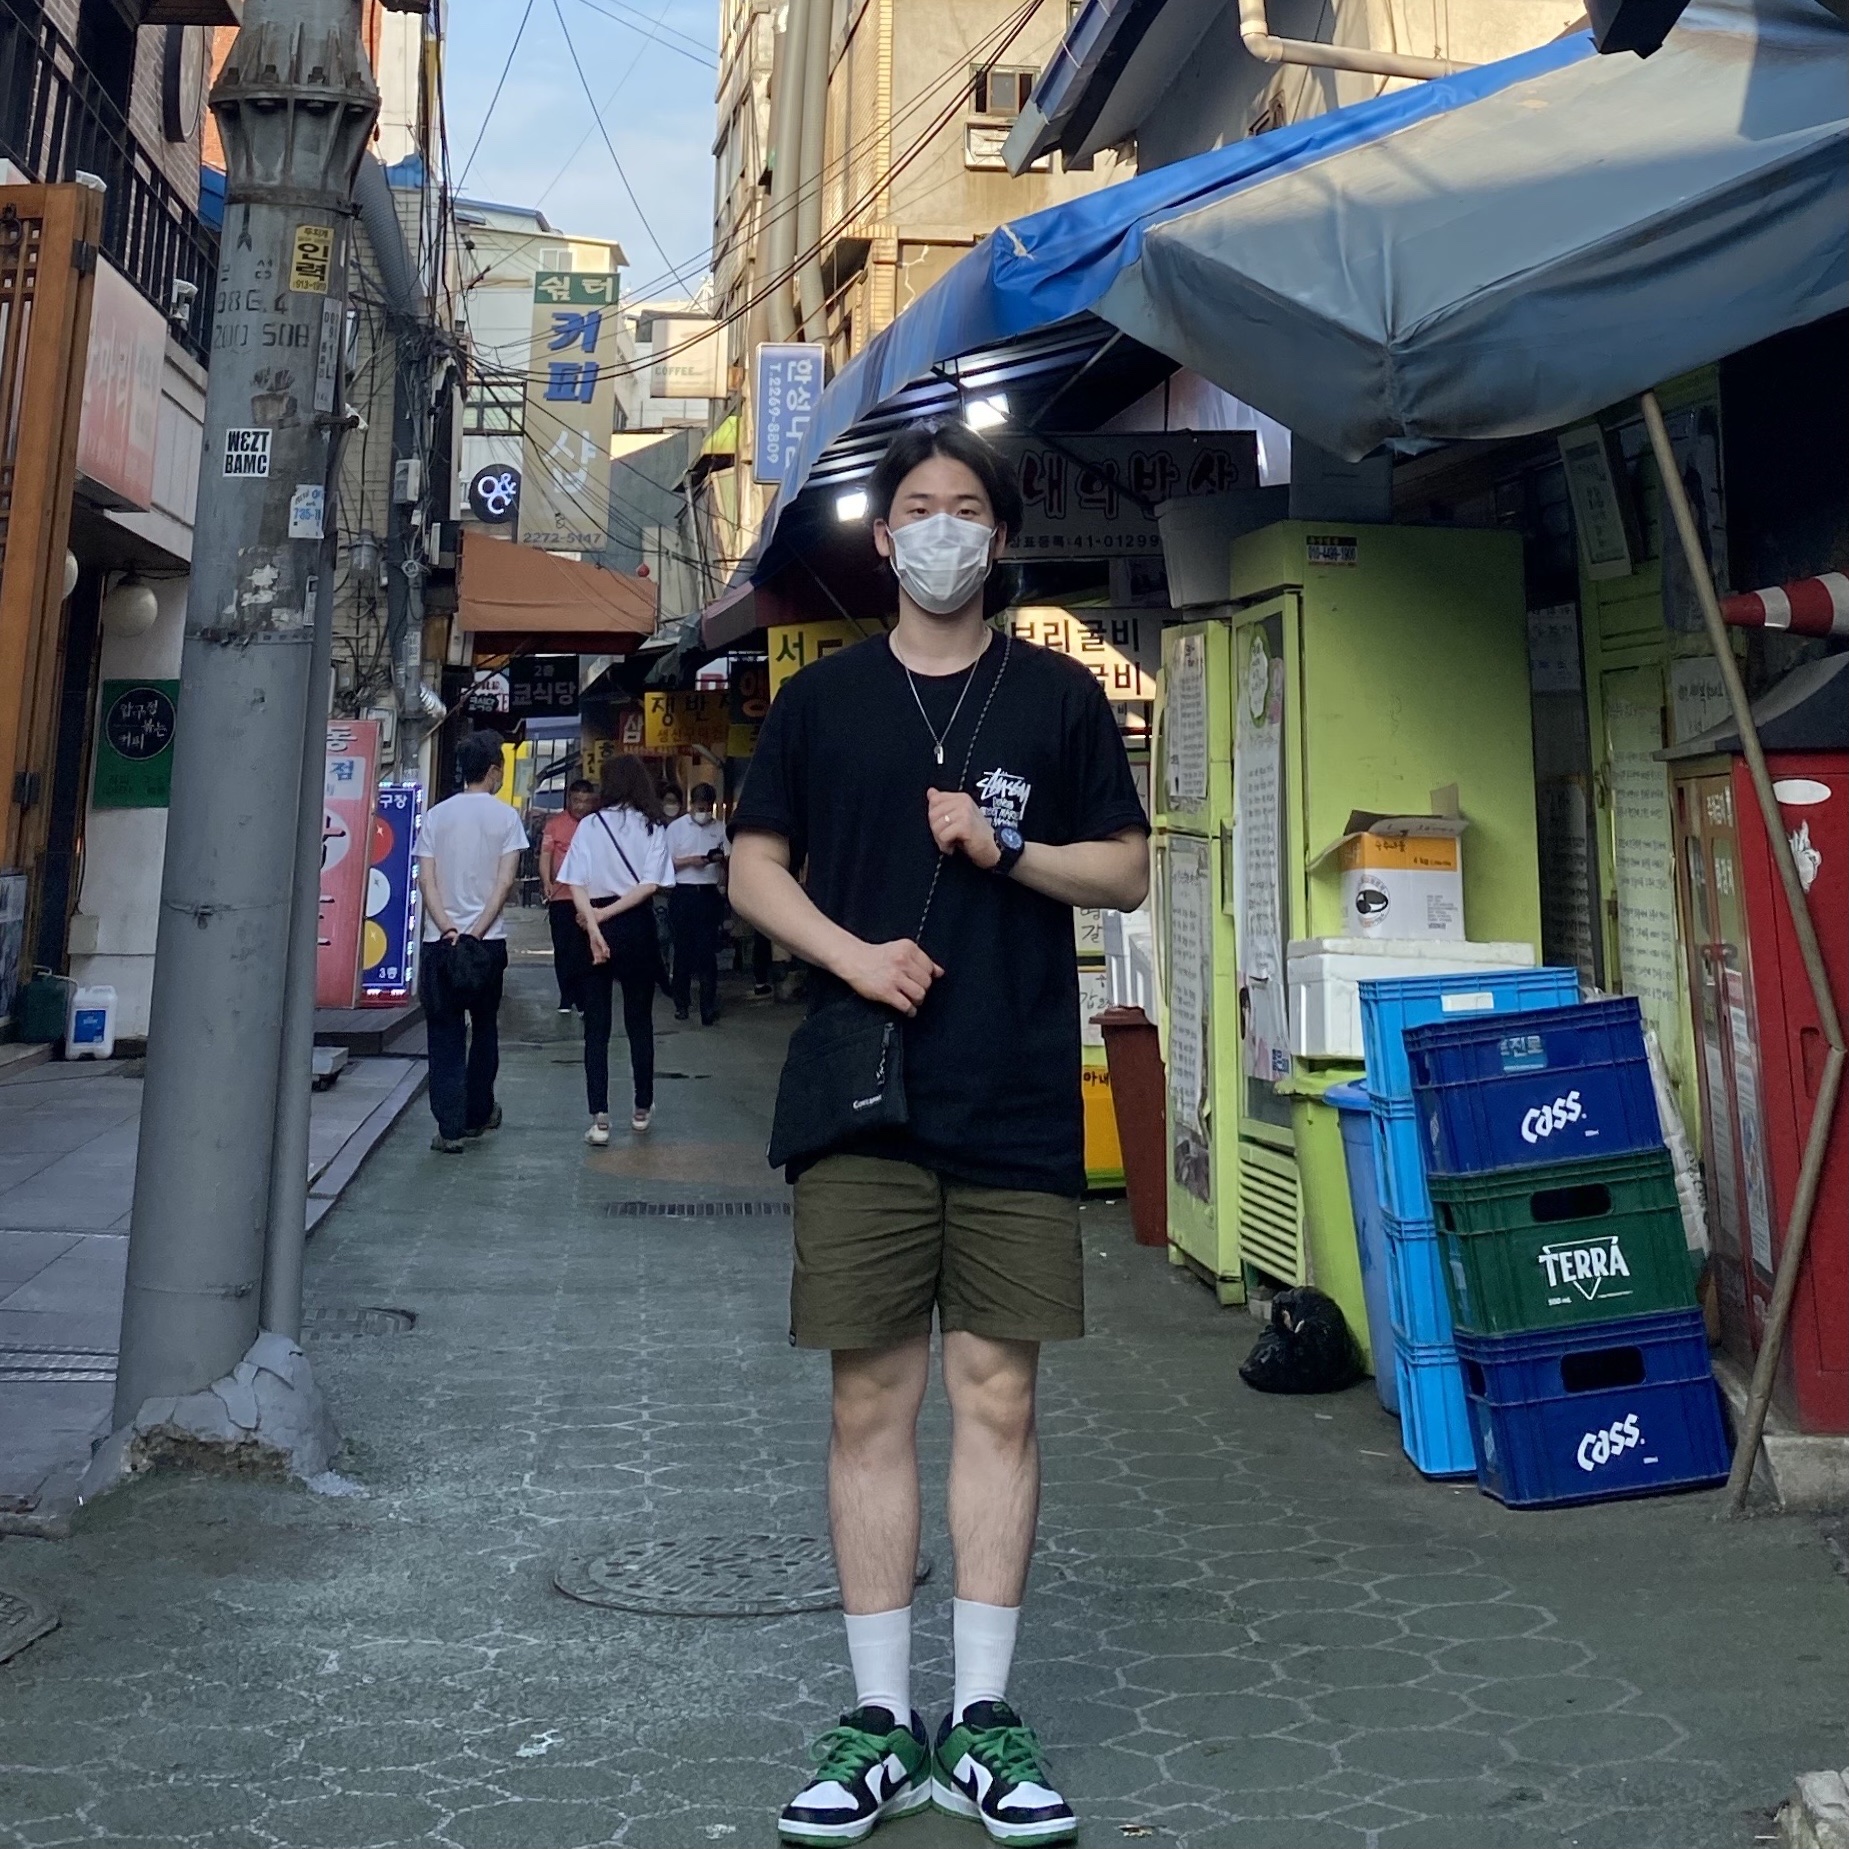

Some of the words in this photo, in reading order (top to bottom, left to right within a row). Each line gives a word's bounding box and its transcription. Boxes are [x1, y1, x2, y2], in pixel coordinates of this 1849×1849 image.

[294, 242, 330, 282] 인력
[538, 276, 613, 302] 쉼터
[544, 310, 602, 404] 커피
[766, 362, 782, 464] T.2269-8809
[224, 454, 267, 474] BAMC
[1011, 618, 1140, 652] 보리굴비
[1537, 1244, 1631, 1288] TERRA
